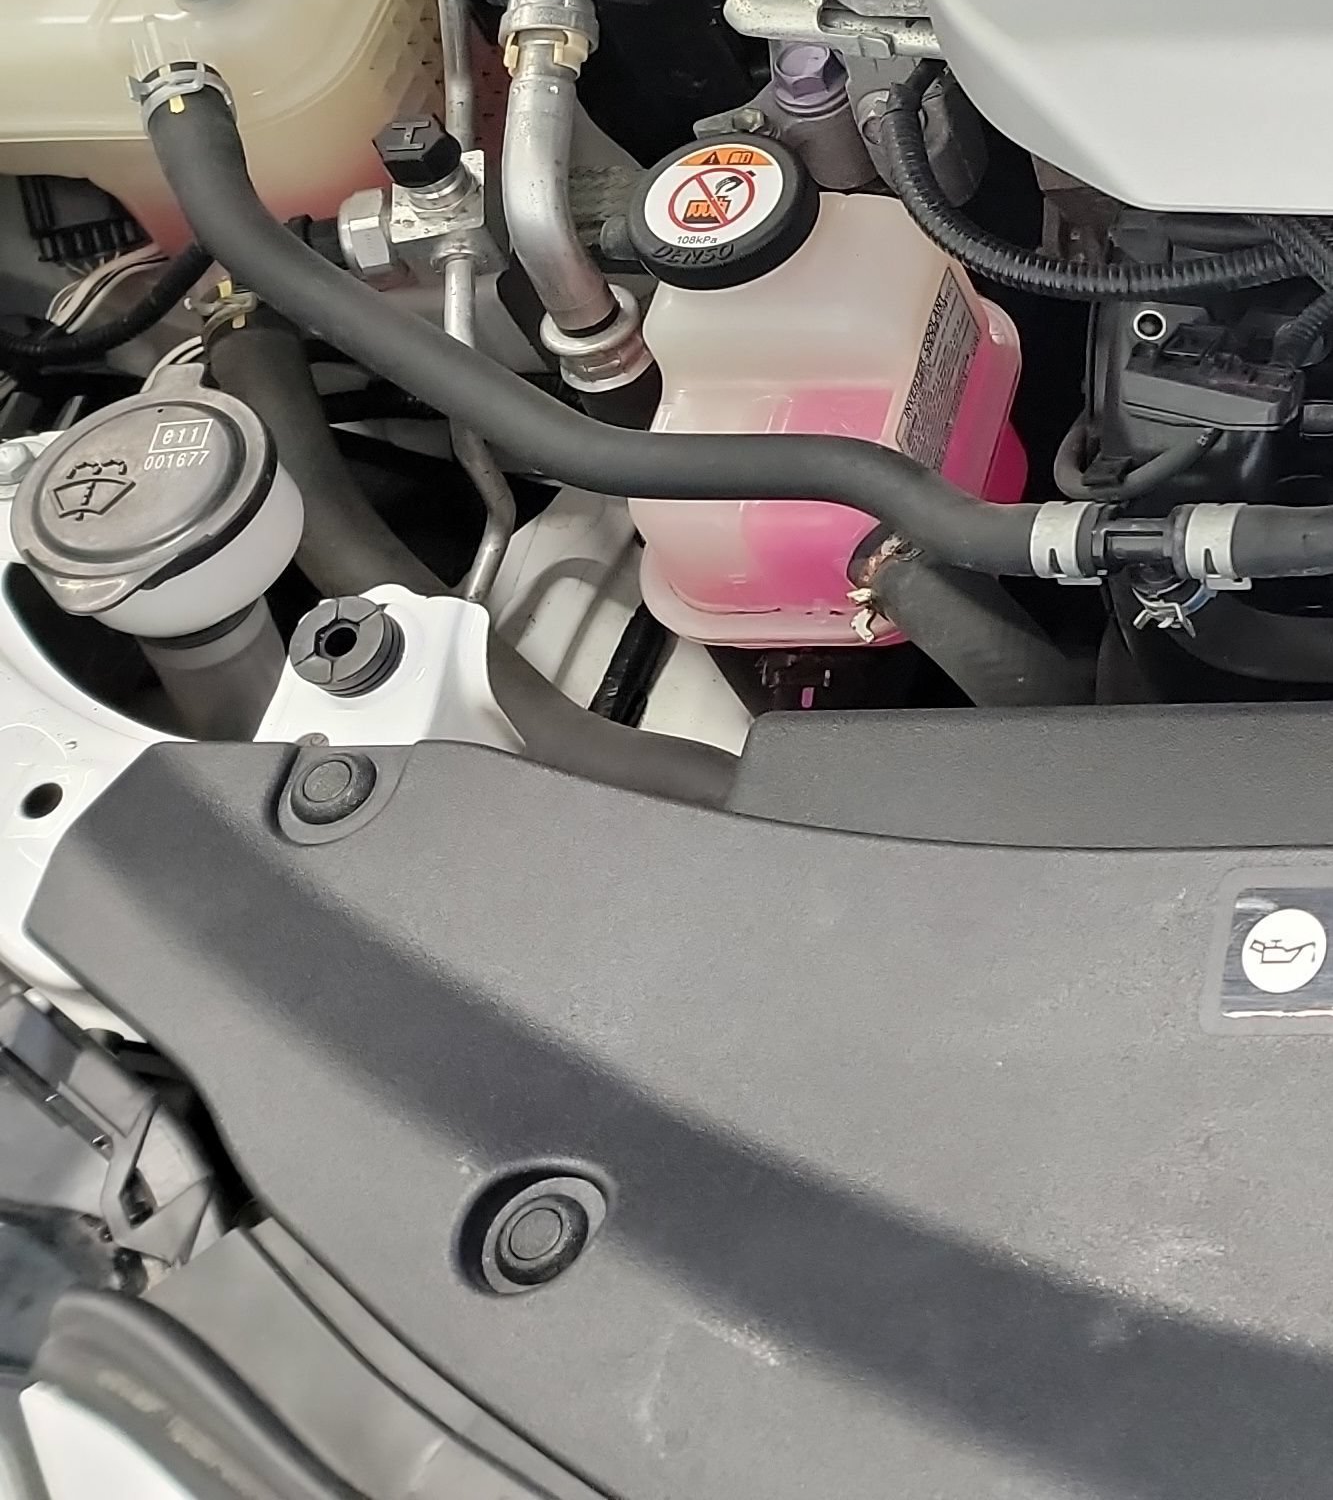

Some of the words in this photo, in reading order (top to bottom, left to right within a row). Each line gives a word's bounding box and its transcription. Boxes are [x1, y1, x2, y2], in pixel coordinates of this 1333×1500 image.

[676, 235, 719, 245] 108kPa
[651, 243, 735, 266] DENSO
[162, 426, 199, 445] e11
[143, 450, 210, 471] 001677
